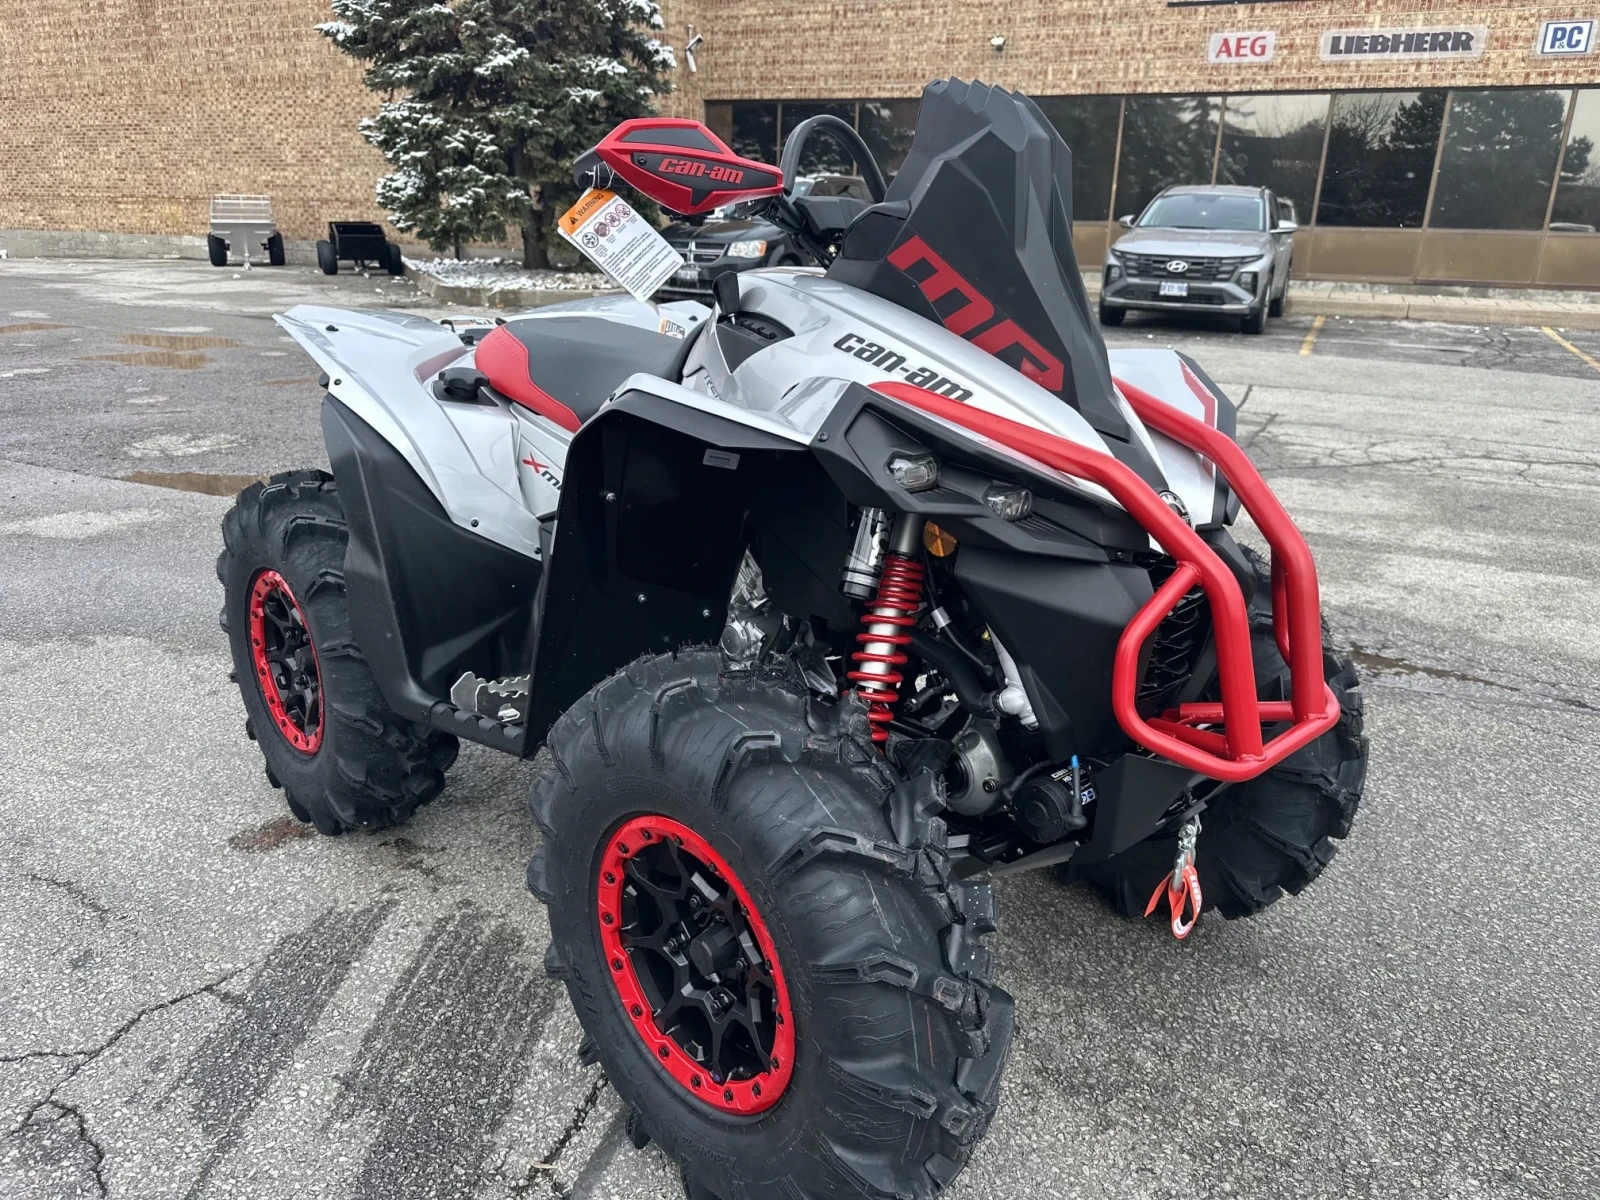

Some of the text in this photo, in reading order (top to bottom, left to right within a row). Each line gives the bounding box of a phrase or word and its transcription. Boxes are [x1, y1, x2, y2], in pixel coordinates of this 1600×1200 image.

[1215, 35, 1267, 59] AEG
[1329, 31, 1474, 55] LIEBHERR
[1549, 25, 1584, 50] P&C
[658, 157, 744, 185] can-am
[576, 192, 605, 217] WARNING
[833, 331, 974, 403] can-am
